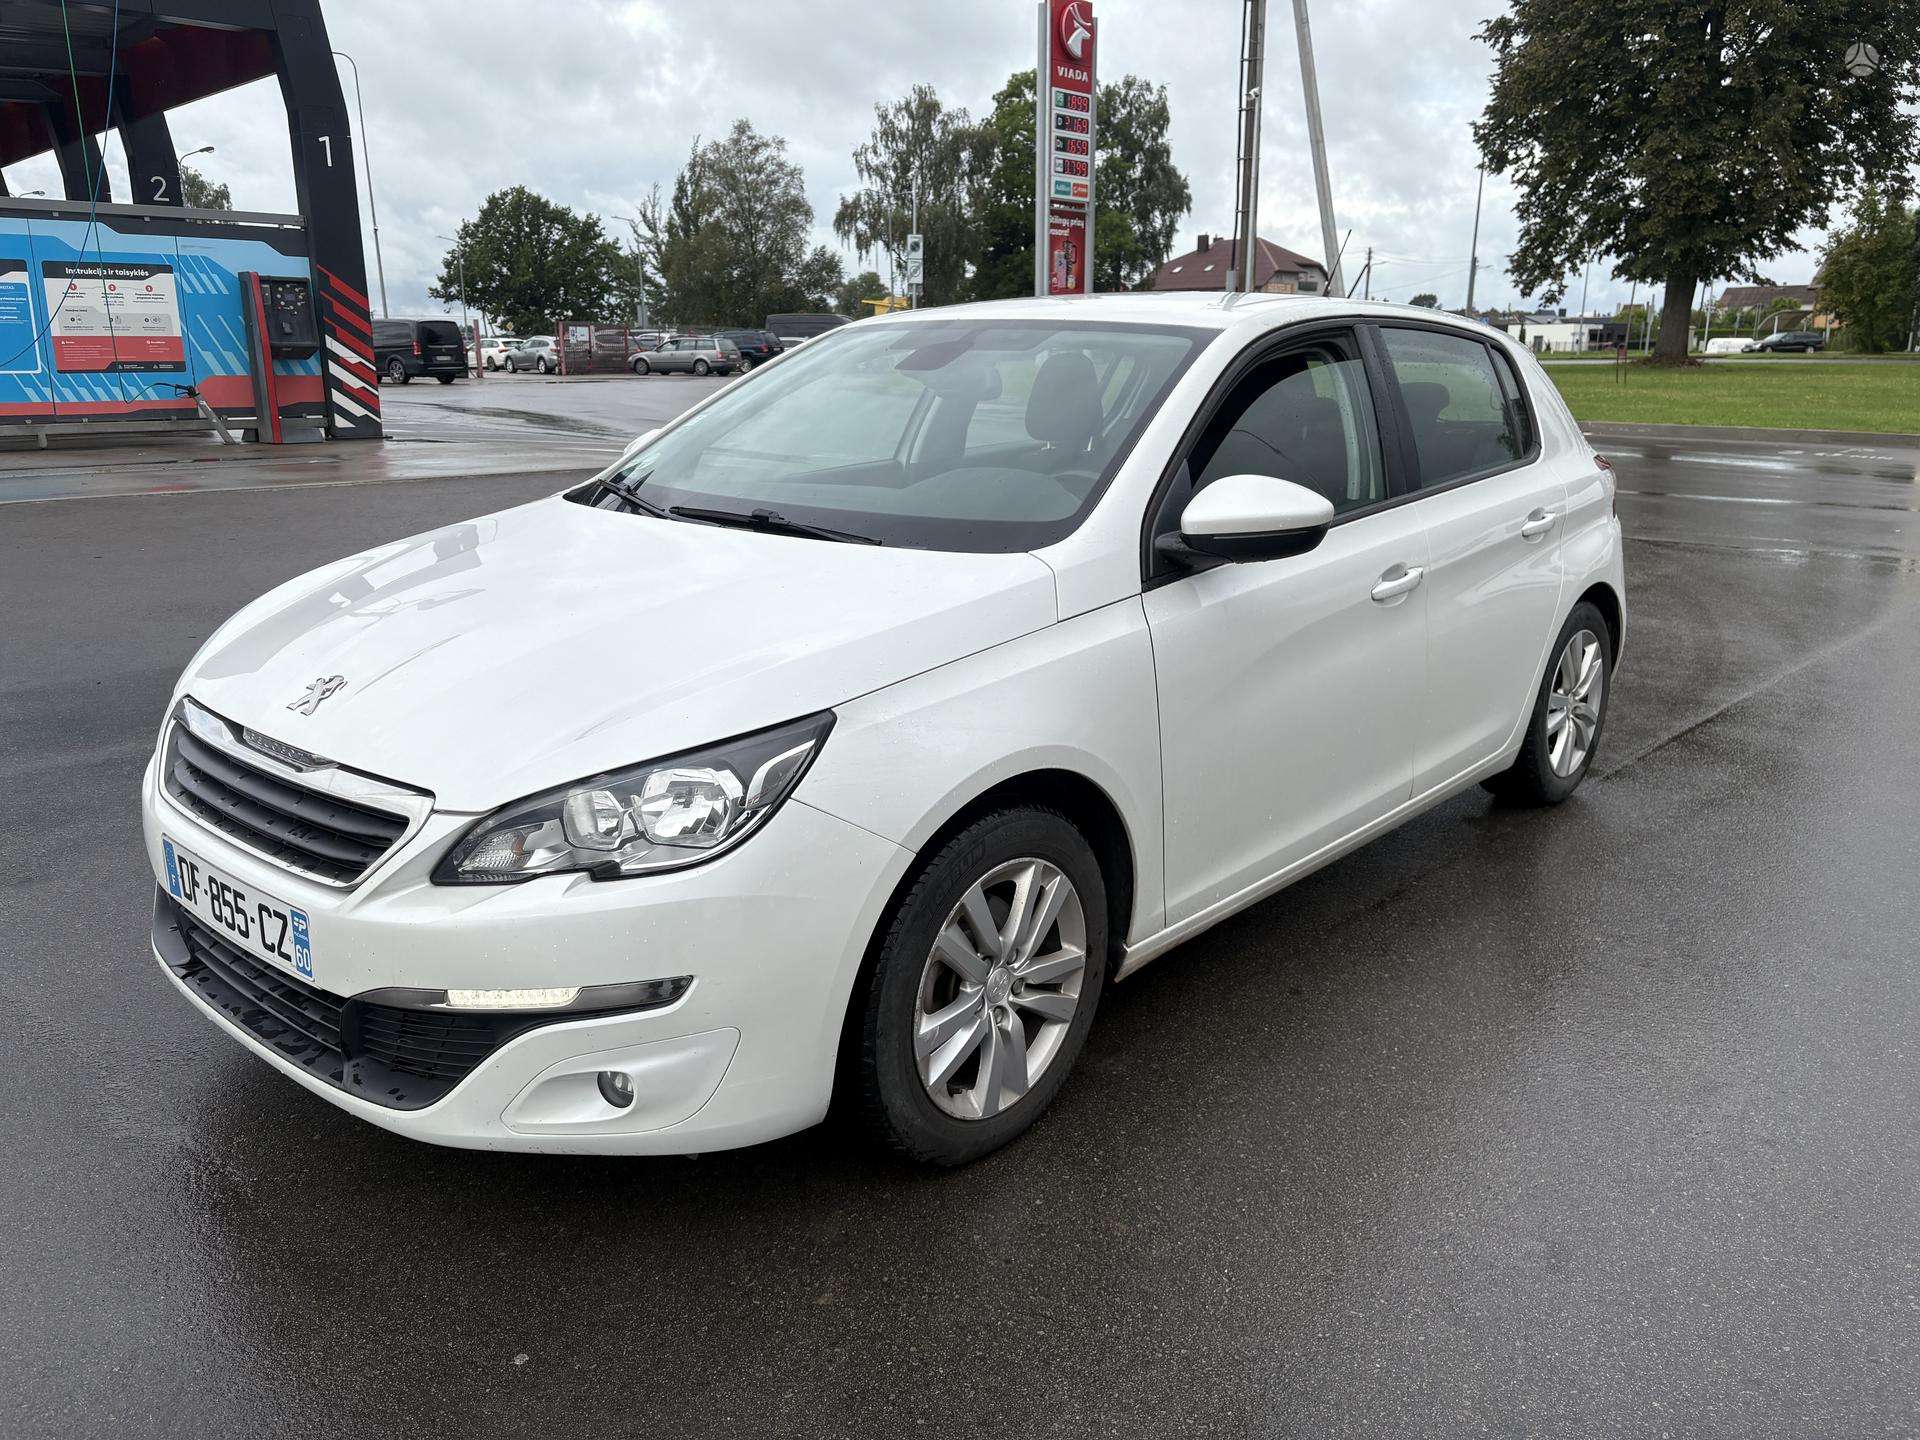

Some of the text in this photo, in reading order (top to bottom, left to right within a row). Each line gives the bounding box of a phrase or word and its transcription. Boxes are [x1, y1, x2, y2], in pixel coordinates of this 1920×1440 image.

[1057, 65, 1089, 82] VIADA
[318, 135, 333, 167] 1
[150, 176, 170, 202] 2
[171, 874, 176, 886] F
[296, 944, 310, 971] 60
